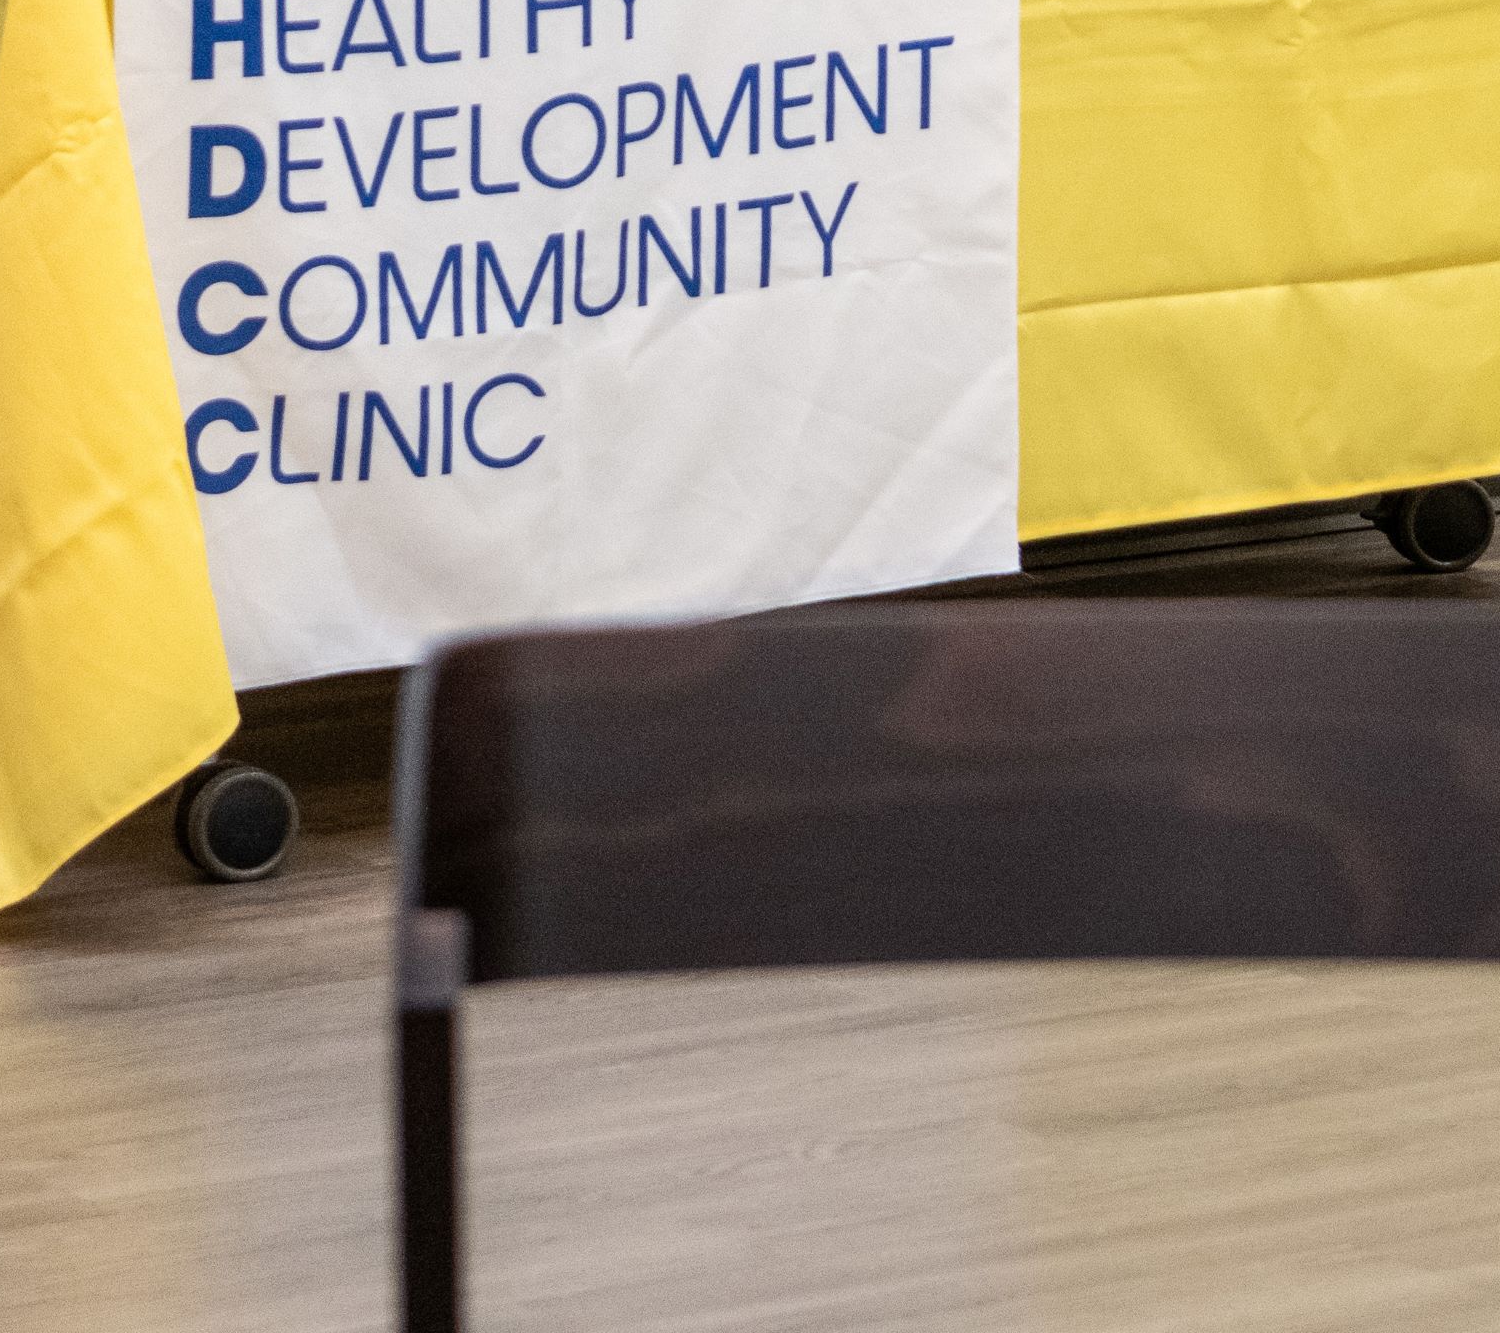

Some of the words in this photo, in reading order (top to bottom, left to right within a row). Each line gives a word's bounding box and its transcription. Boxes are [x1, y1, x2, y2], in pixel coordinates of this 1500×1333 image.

[188, 36, 955, 219] DEVELOPMENT
[177, 182, 859, 356] COMMUNITY
[186, 373, 546, 494] CLINIC
